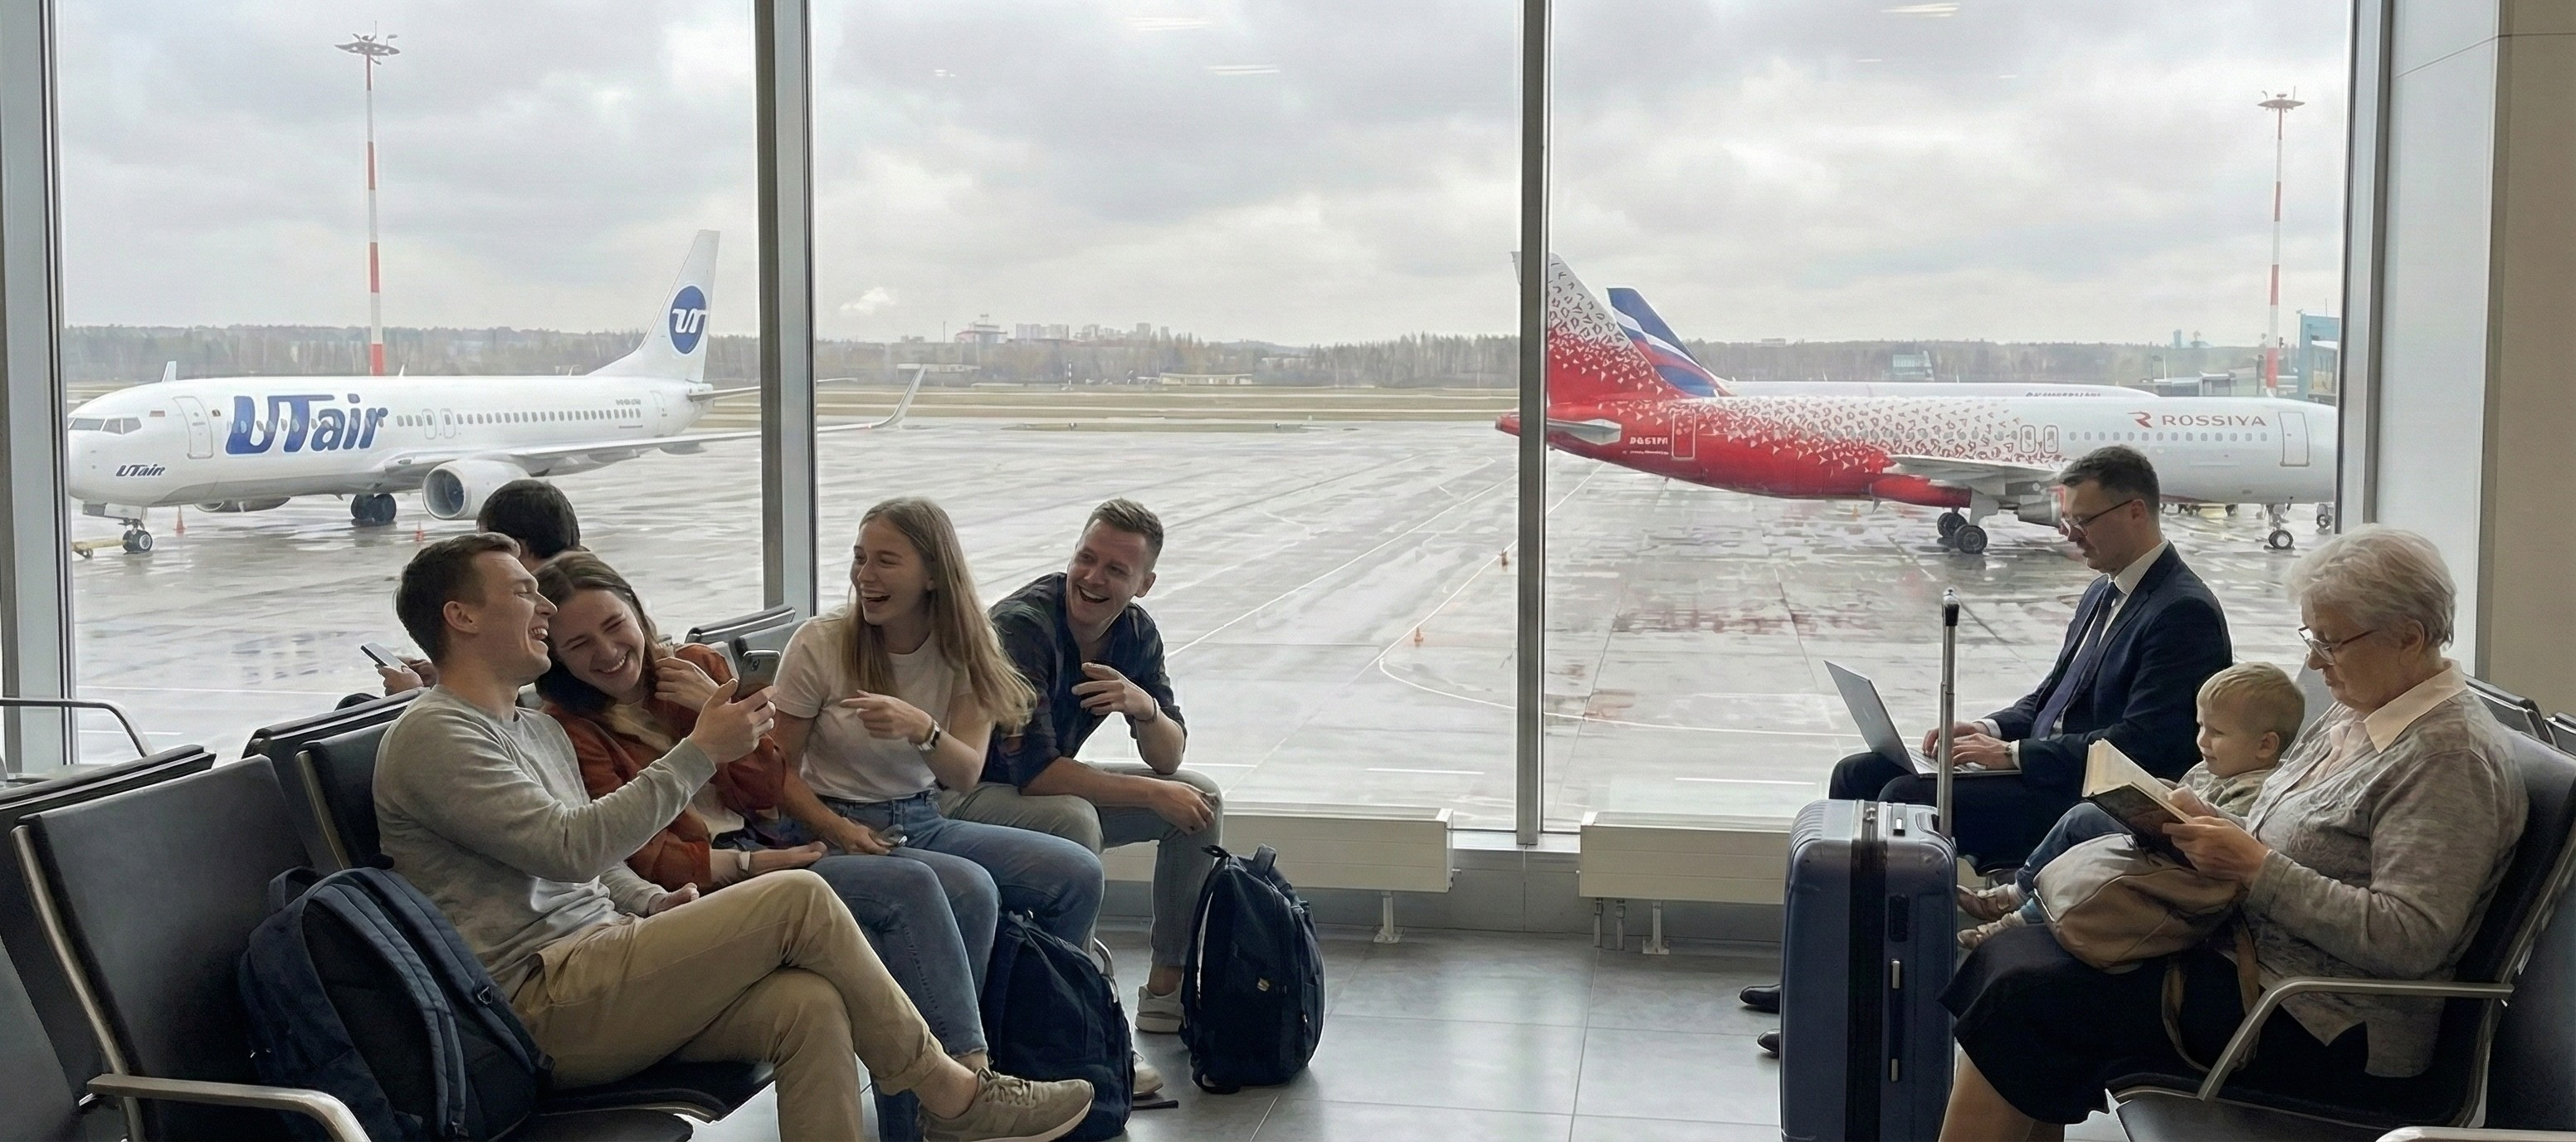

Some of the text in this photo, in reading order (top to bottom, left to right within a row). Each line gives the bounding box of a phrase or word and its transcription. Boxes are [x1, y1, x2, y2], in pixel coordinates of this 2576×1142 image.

[225, 393, 388, 455] UTair
[2162, 415, 2266, 427] ROSSIYA
[115, 463, 166, 477] UTair
